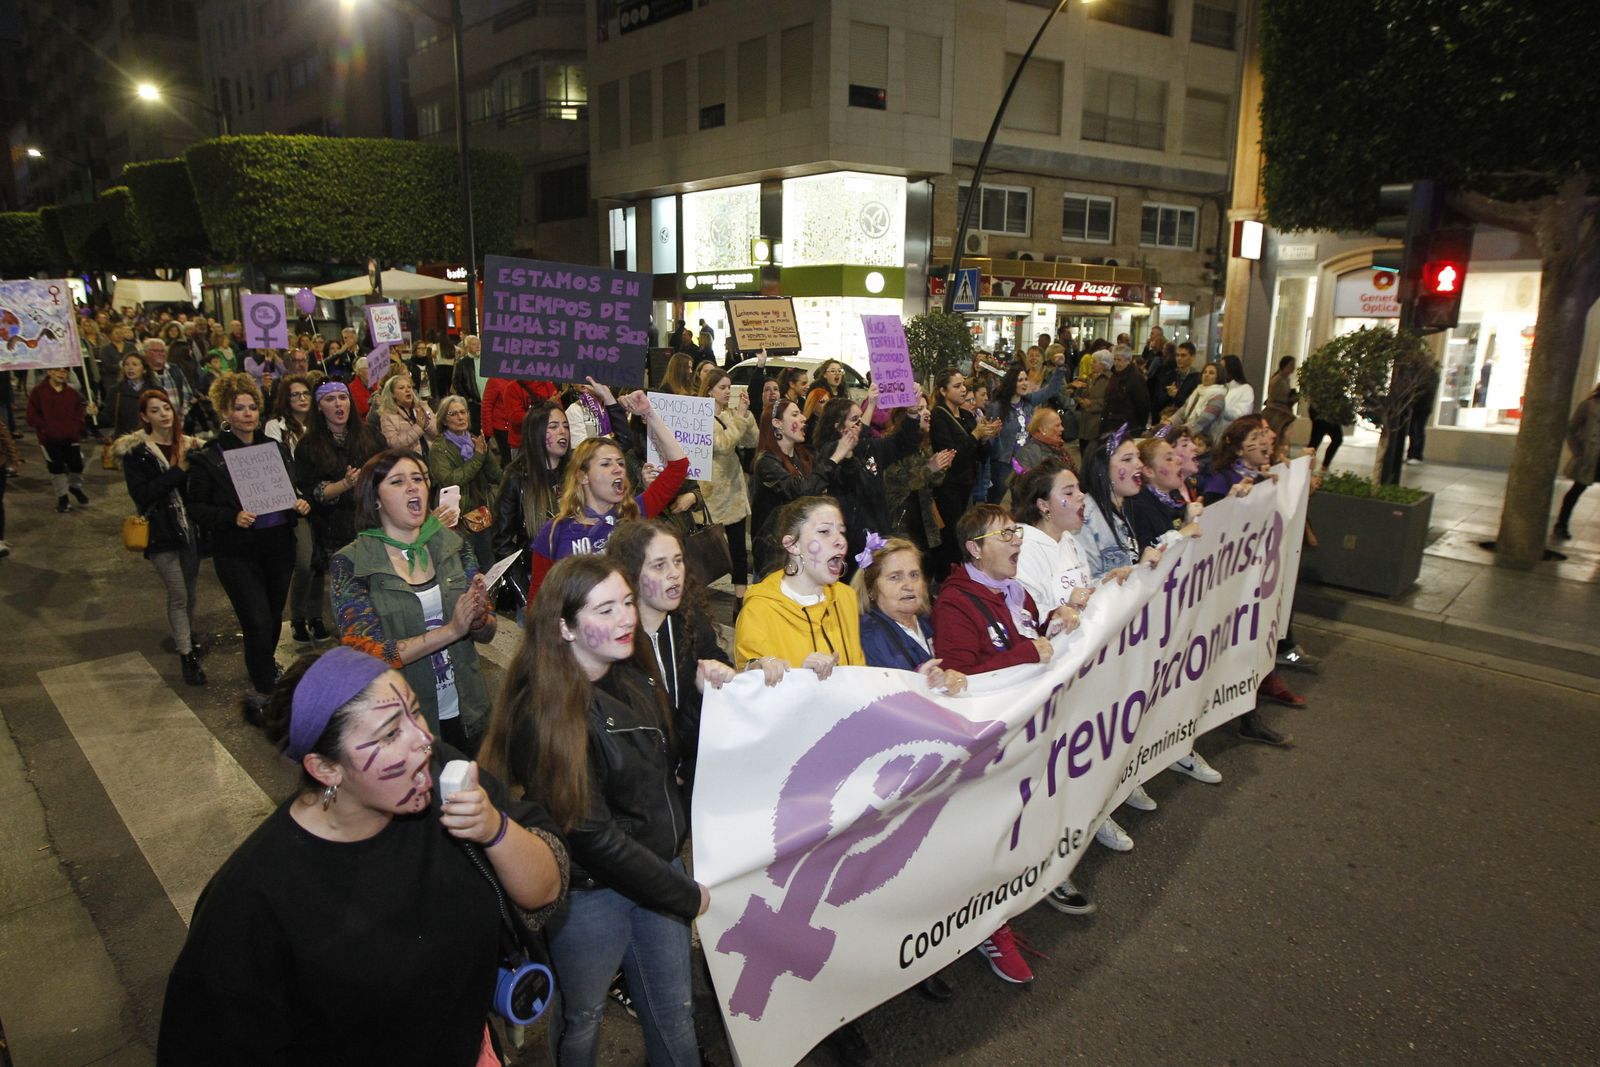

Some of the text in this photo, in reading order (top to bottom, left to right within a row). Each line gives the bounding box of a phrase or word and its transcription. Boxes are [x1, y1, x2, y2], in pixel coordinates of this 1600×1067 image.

[498, 268, 640, 296] ESTAMOS EN
[1022, 279, 1122, 296] Parrilla Pasaje
[1360, 293, 1399, 302] Genera
[600, 302, 631, 321] DE
[484, 312, 648, 346] LUCHA SI POR SER
[492, 337, 620, 363] LIBRES NOS
[499, 360, 575, 379] LLAMAN
[674, 430, 712, 446] BRUJAS
[572, 537, 591, 555] NO
[1058, 827, 1082, 858] de
